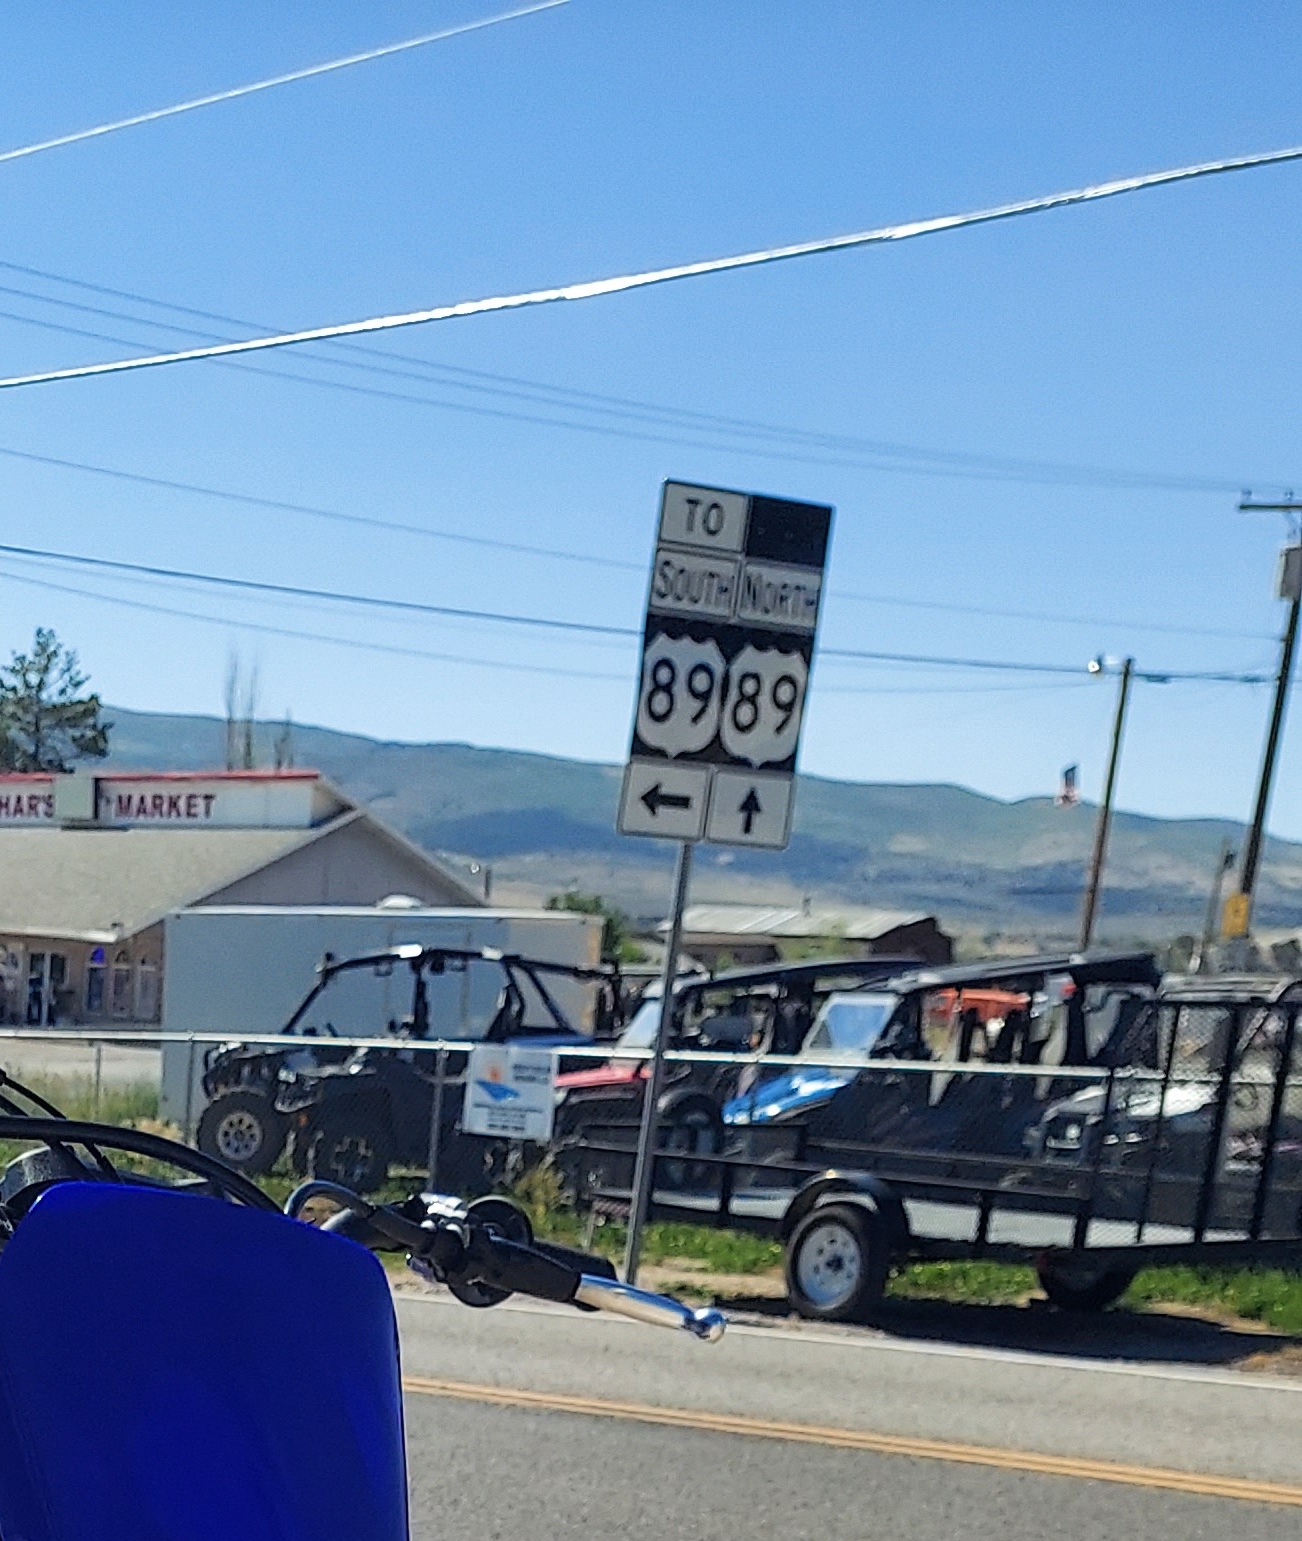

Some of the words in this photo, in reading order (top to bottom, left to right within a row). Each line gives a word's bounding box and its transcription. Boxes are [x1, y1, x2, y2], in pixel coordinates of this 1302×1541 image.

[685, 499, 724, 535] TO
[657, 560, 735, 613] SOUTH
[744, 573, 819, 621] NORTH
[648, 659, 715, 724] 89
[732, 672, 798, 735] 89
[115, 793, 216, 819] MARKET
